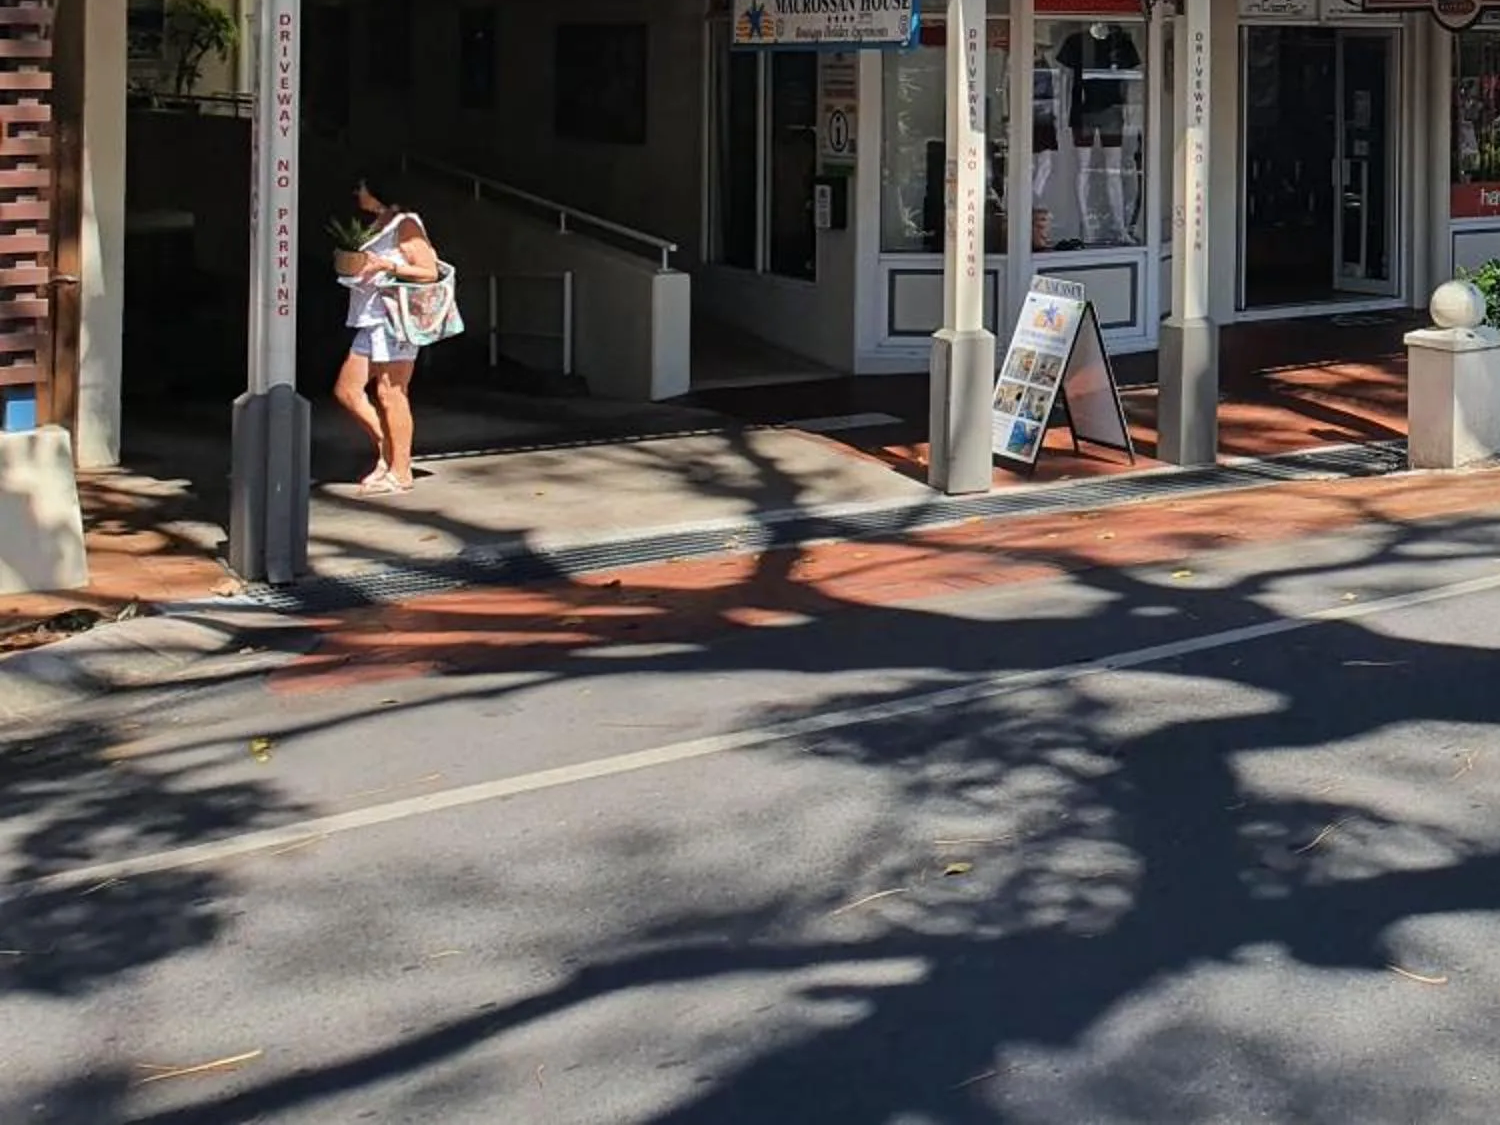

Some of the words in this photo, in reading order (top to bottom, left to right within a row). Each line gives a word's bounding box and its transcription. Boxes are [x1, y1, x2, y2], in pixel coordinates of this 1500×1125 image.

[277, 14, 292, 137] DRIVEWAY
[968, 28, 978, 132] DRIVEWAY
[1194, 33, 1203, 123] DRIVEWAY
[277, 160, 289, 188] NO
[968, 148, 976, 170] NO
[277, 209, 289, 316] PARKING
[967, 189, 976, 277] PARKING
